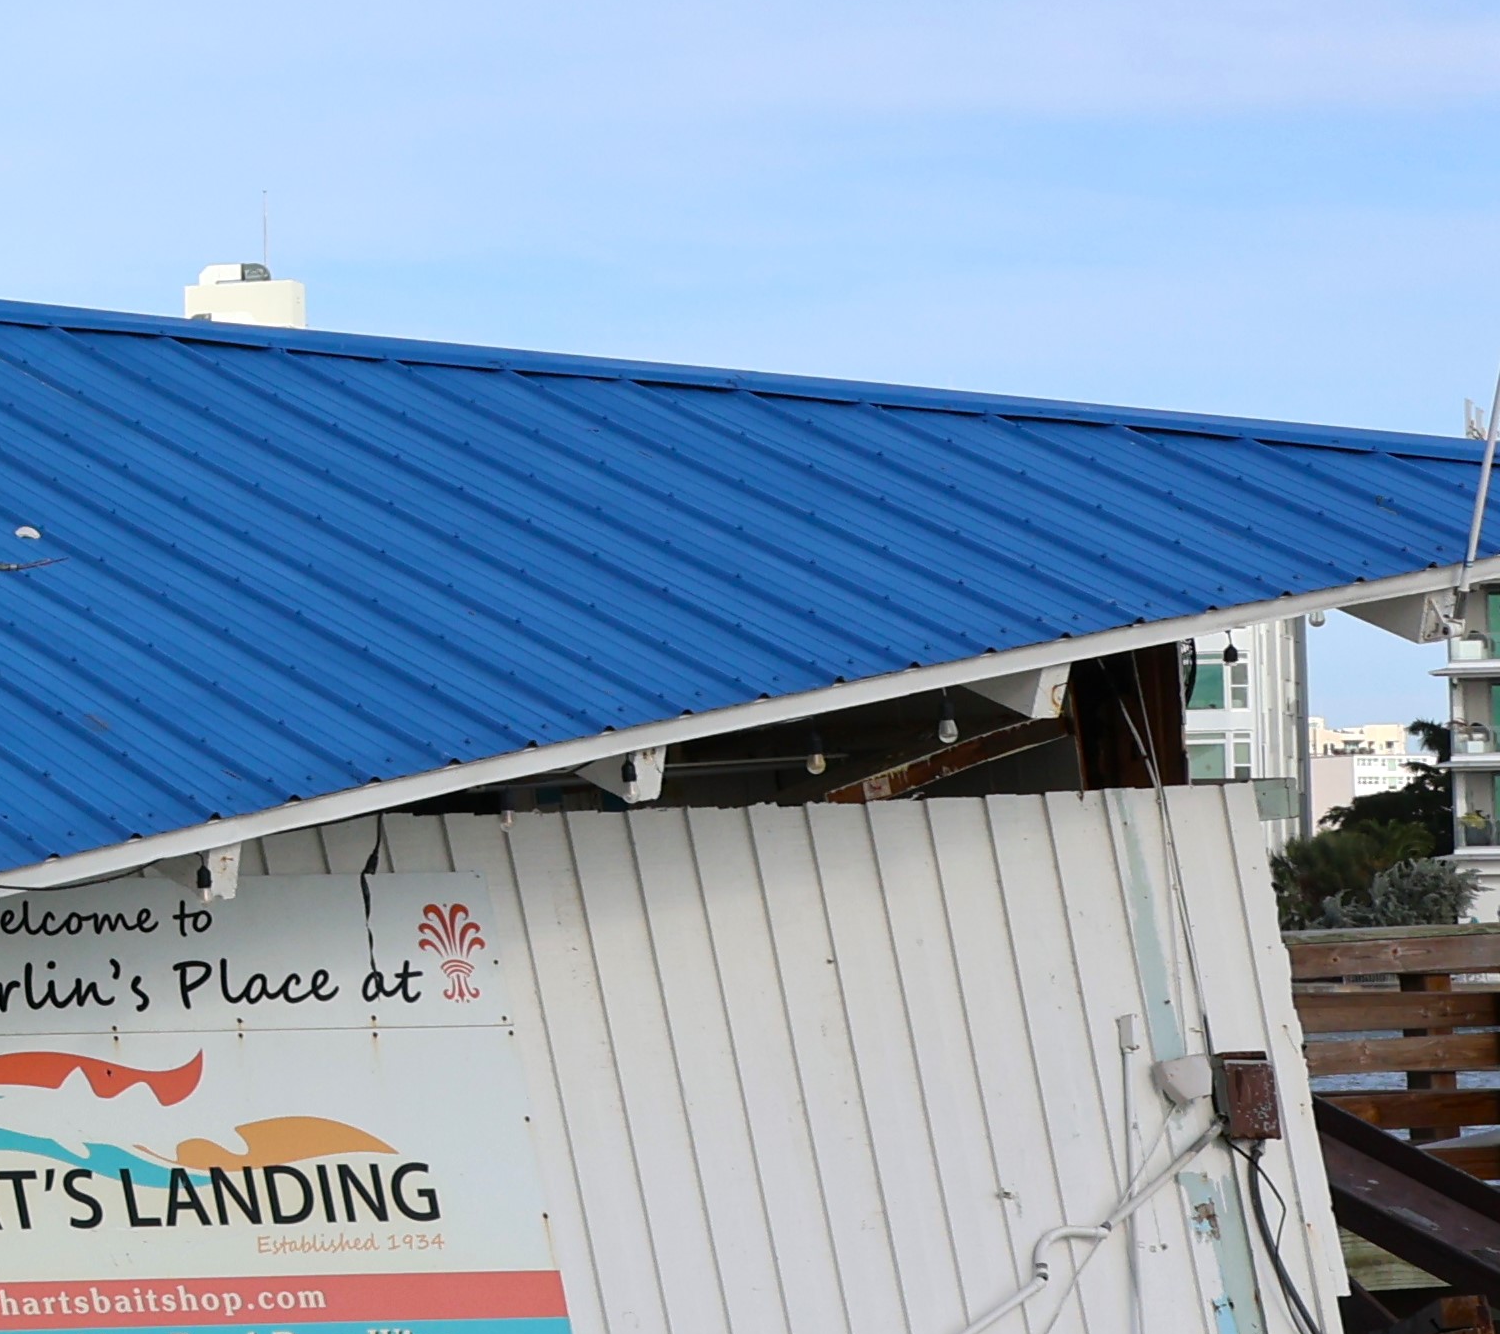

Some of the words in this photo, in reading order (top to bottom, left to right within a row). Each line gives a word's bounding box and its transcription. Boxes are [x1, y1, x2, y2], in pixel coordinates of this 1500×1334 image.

[172, 900, 212, 937] to
[172, 958, 340, 1009] Place
[362, 960, 423, 1003] at
[118, 1161, 442, 1228] LANDING
[256, 1232, 379, 1255] Established
[387, 1232, 445, 1253] 1934
